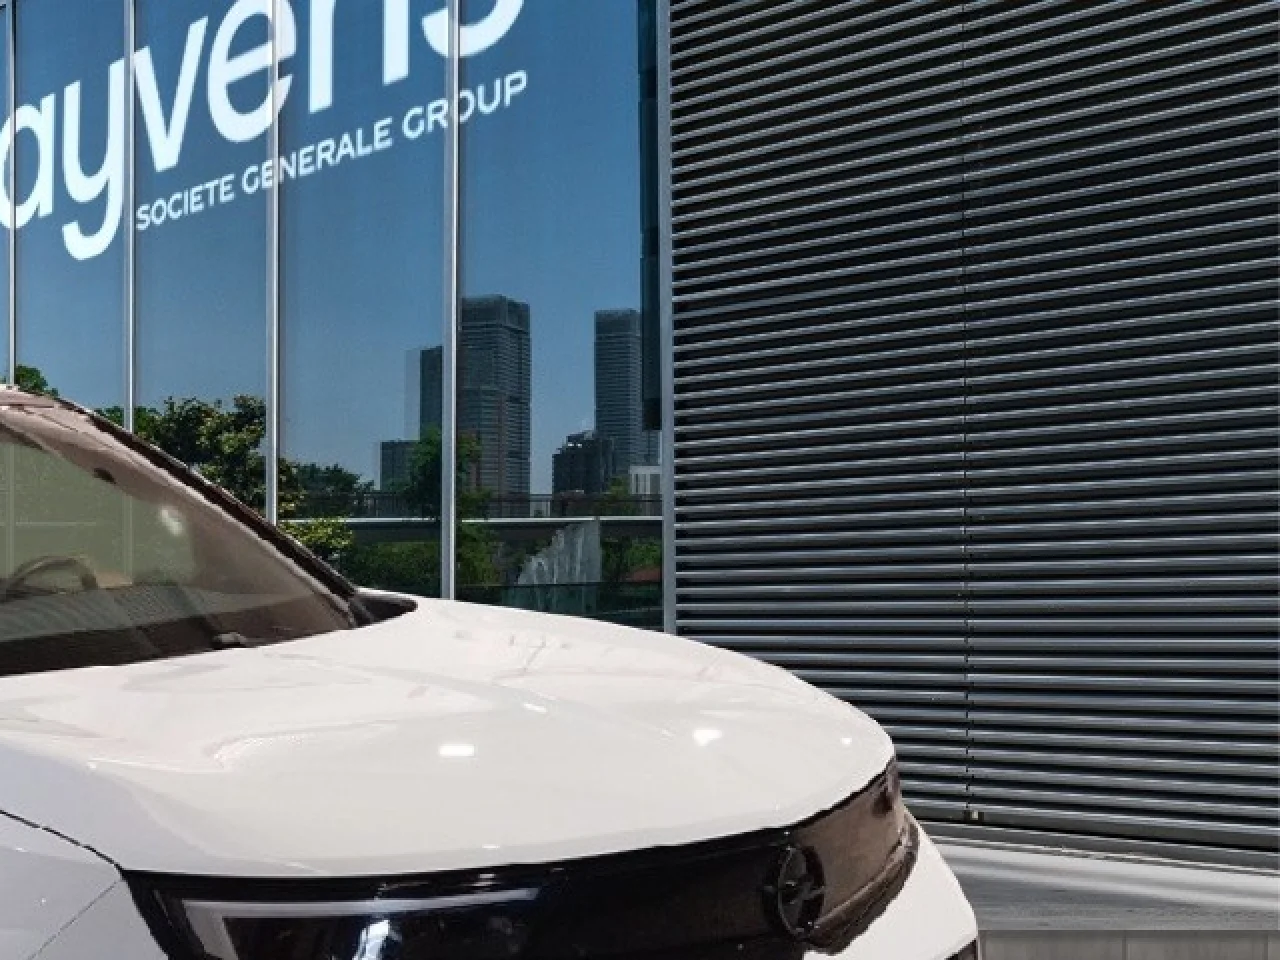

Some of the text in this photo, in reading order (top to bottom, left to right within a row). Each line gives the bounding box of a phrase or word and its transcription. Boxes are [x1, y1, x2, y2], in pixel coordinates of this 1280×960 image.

[136, 70, 528, 230] SOCIETE GENERALE GROUP
